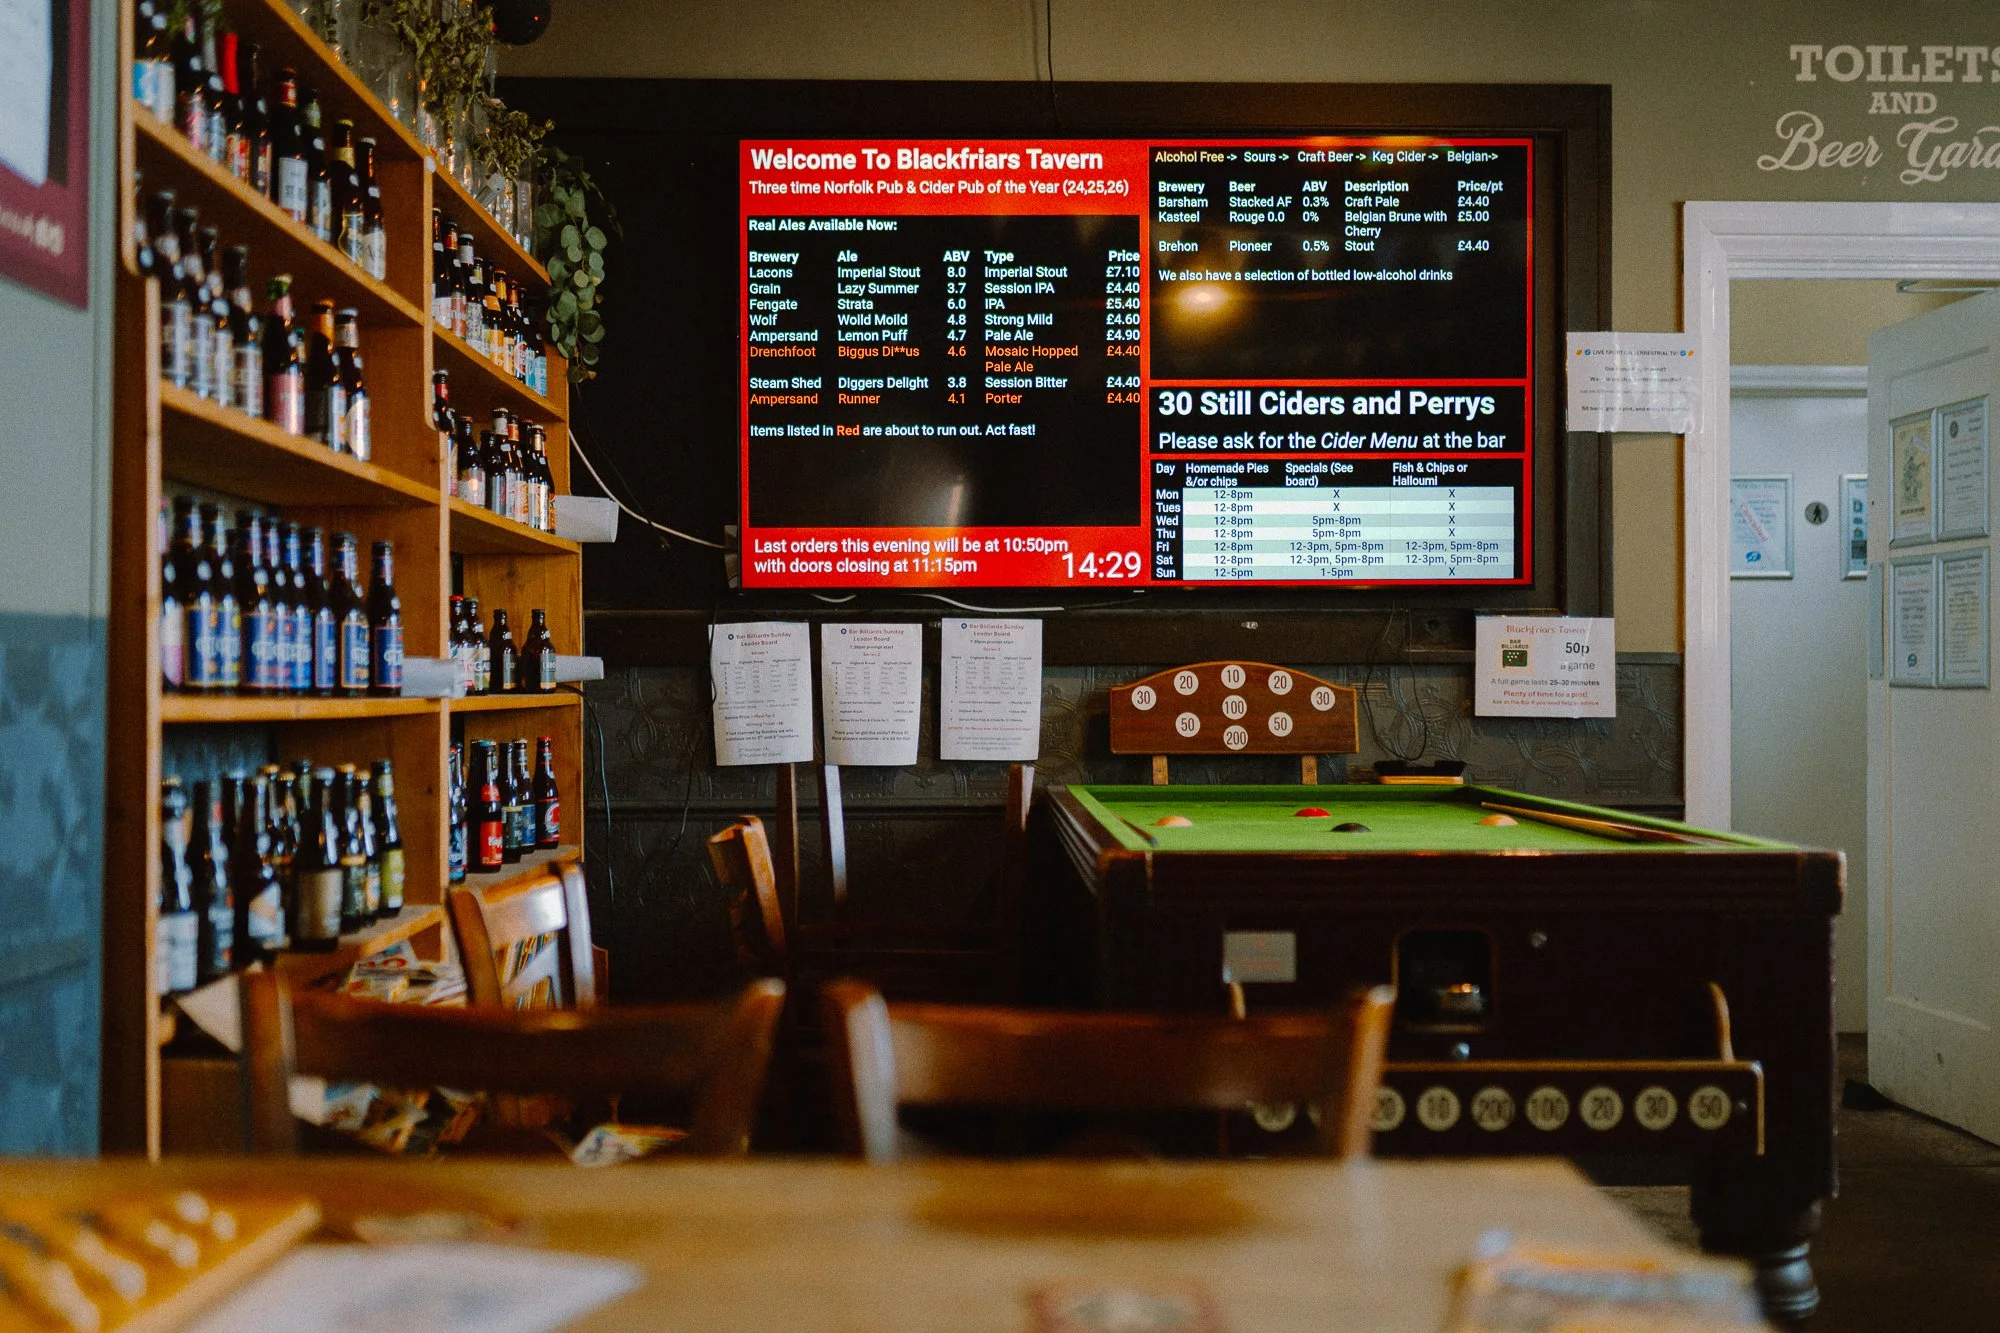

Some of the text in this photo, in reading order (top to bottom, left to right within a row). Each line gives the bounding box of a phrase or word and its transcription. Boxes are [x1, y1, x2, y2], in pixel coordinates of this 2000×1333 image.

[1868, 92, 1937, 114] AND
[1756, 110, 1883, 170] Beer
[751, 148, 1102, 170] Welcome To Blackfriars Tavern
[749, 179, 1128, 196] Three time Norfolk Pub & Cider Pub of the Year (24,25,26)
[1159, 180, 1503, 194] Brewery Beer ABV Description Price/pt
[1159, 196, 1489, 207] Barsham Stacked AF 0.3% Craft Pale £4.40
[749, 219, 897, 230] Real Ales Available Now:
[1159, 240, 1489, 251] Brehon Pioneer 0.5% Stout £4.40
[750, 250, 1140, 264] Brewery Ale ABV Type Price
[750, 266, 1140, 280] Lacons Imperial Stout 8.0 Imperial Stout £7.10
[750, 282, 1140, 296] Grain Lazy Summer 3.7 Session IPA £4.40
[750, 346, 816, 357] Drenchfoot
[839, 346, 878, 359] Biggus
[948, 346, 966, 356] 4.6
[986, 346, 1028, 356] Mosaic
[1032, 345, 1078, 358] Hopped
[1107, 346, 1140, 356] £4.40
[1159, 390, 1494, 420] 30 Still Ciders and Perrys
[1160, 432, 1506, 449] Please ask for the Cider Menu at the bar
[1156, 489, 1455, 501] Mon 12-8pm X X
[755, 537, 1070, 554] Last orders this evening will be at 10:50pm
[754, 557, 977, 574] with doors closing at 11:15pm
[1062, 552, 1141, 578] 14:29
[1566, 642, 1589, 656] 50p
[1568, 663, 1595, 671] game
[1180, 676, 1192, 689] 20
[1227, 670, 1239, 682] 10
[1274, 676, 1286, 689] 20
[1137, 691, 1150, 704] 30
[1316, 692, 1329, 705] 30
[1225, 701, 1244, 714] 100
[1182, 718, 1194, 731] 50
[1274, 717, 1287, 730] 50
[1226, 732, 1246, 746] 200
[1592, 1095, 1615, 1121] 20
[1645, 1095, 1668, 1121] 30
[1698, 1094, 1722, 1120] 50
